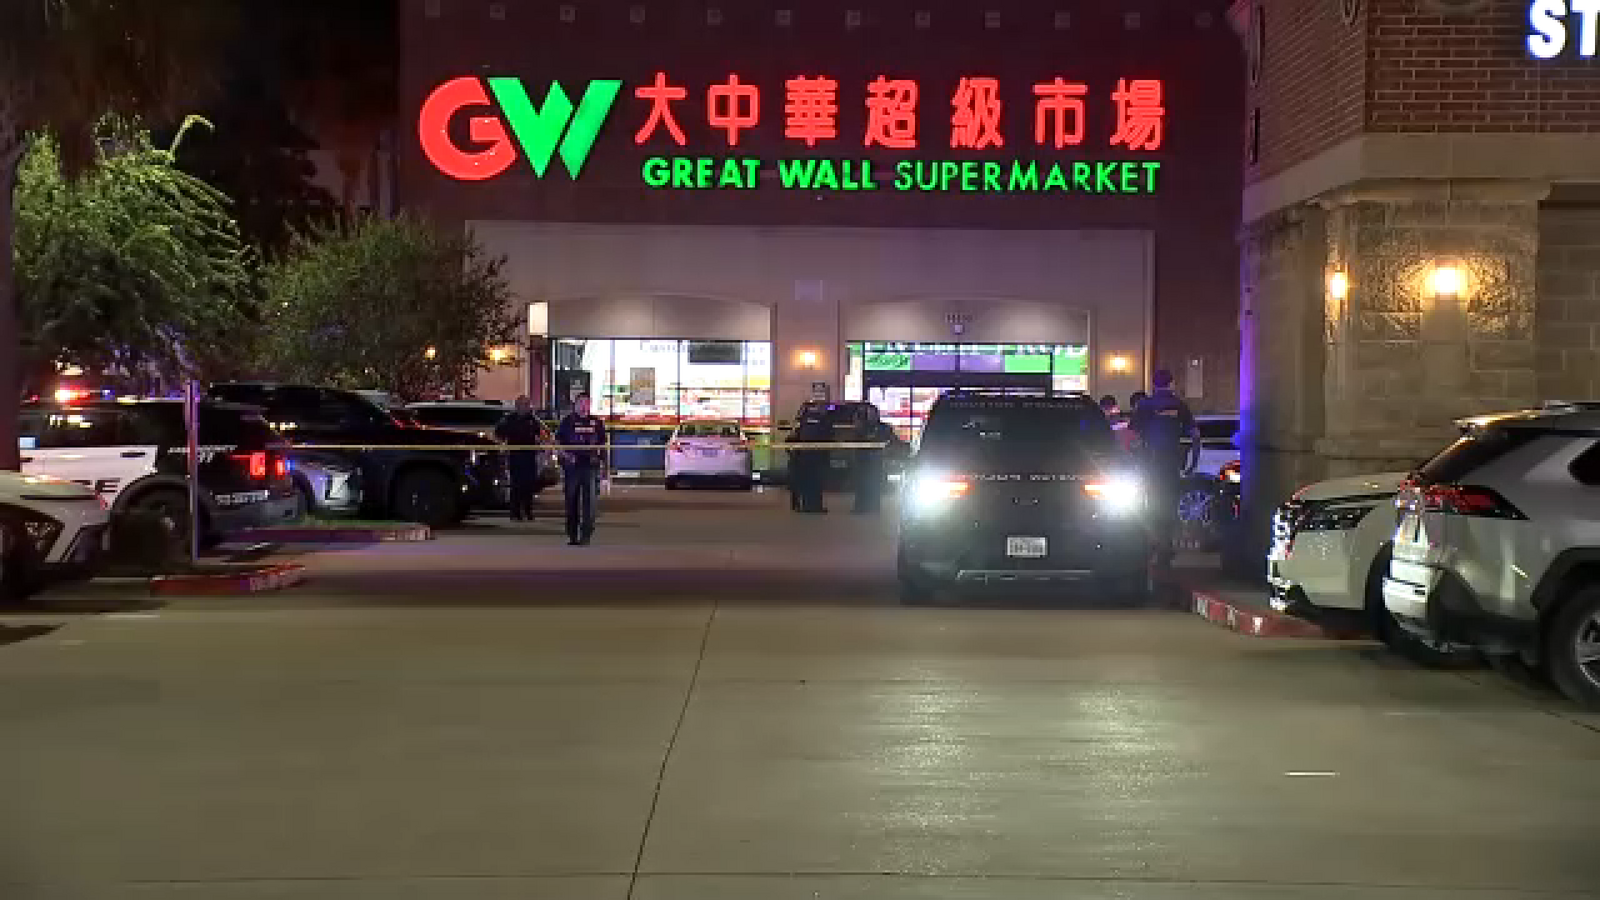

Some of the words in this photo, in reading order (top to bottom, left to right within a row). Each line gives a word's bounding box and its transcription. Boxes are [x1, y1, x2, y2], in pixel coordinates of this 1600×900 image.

[1527, 0, 1600, 59] ST
[418, 75, 621, 181] GW
[634, 71, 1166, 151] 大中華超級市場
[642, 157, 761, 189] GREAT
[779, 159, 876, 191] WALL
[894, 160, 1162, 193] SUPERMARKET
